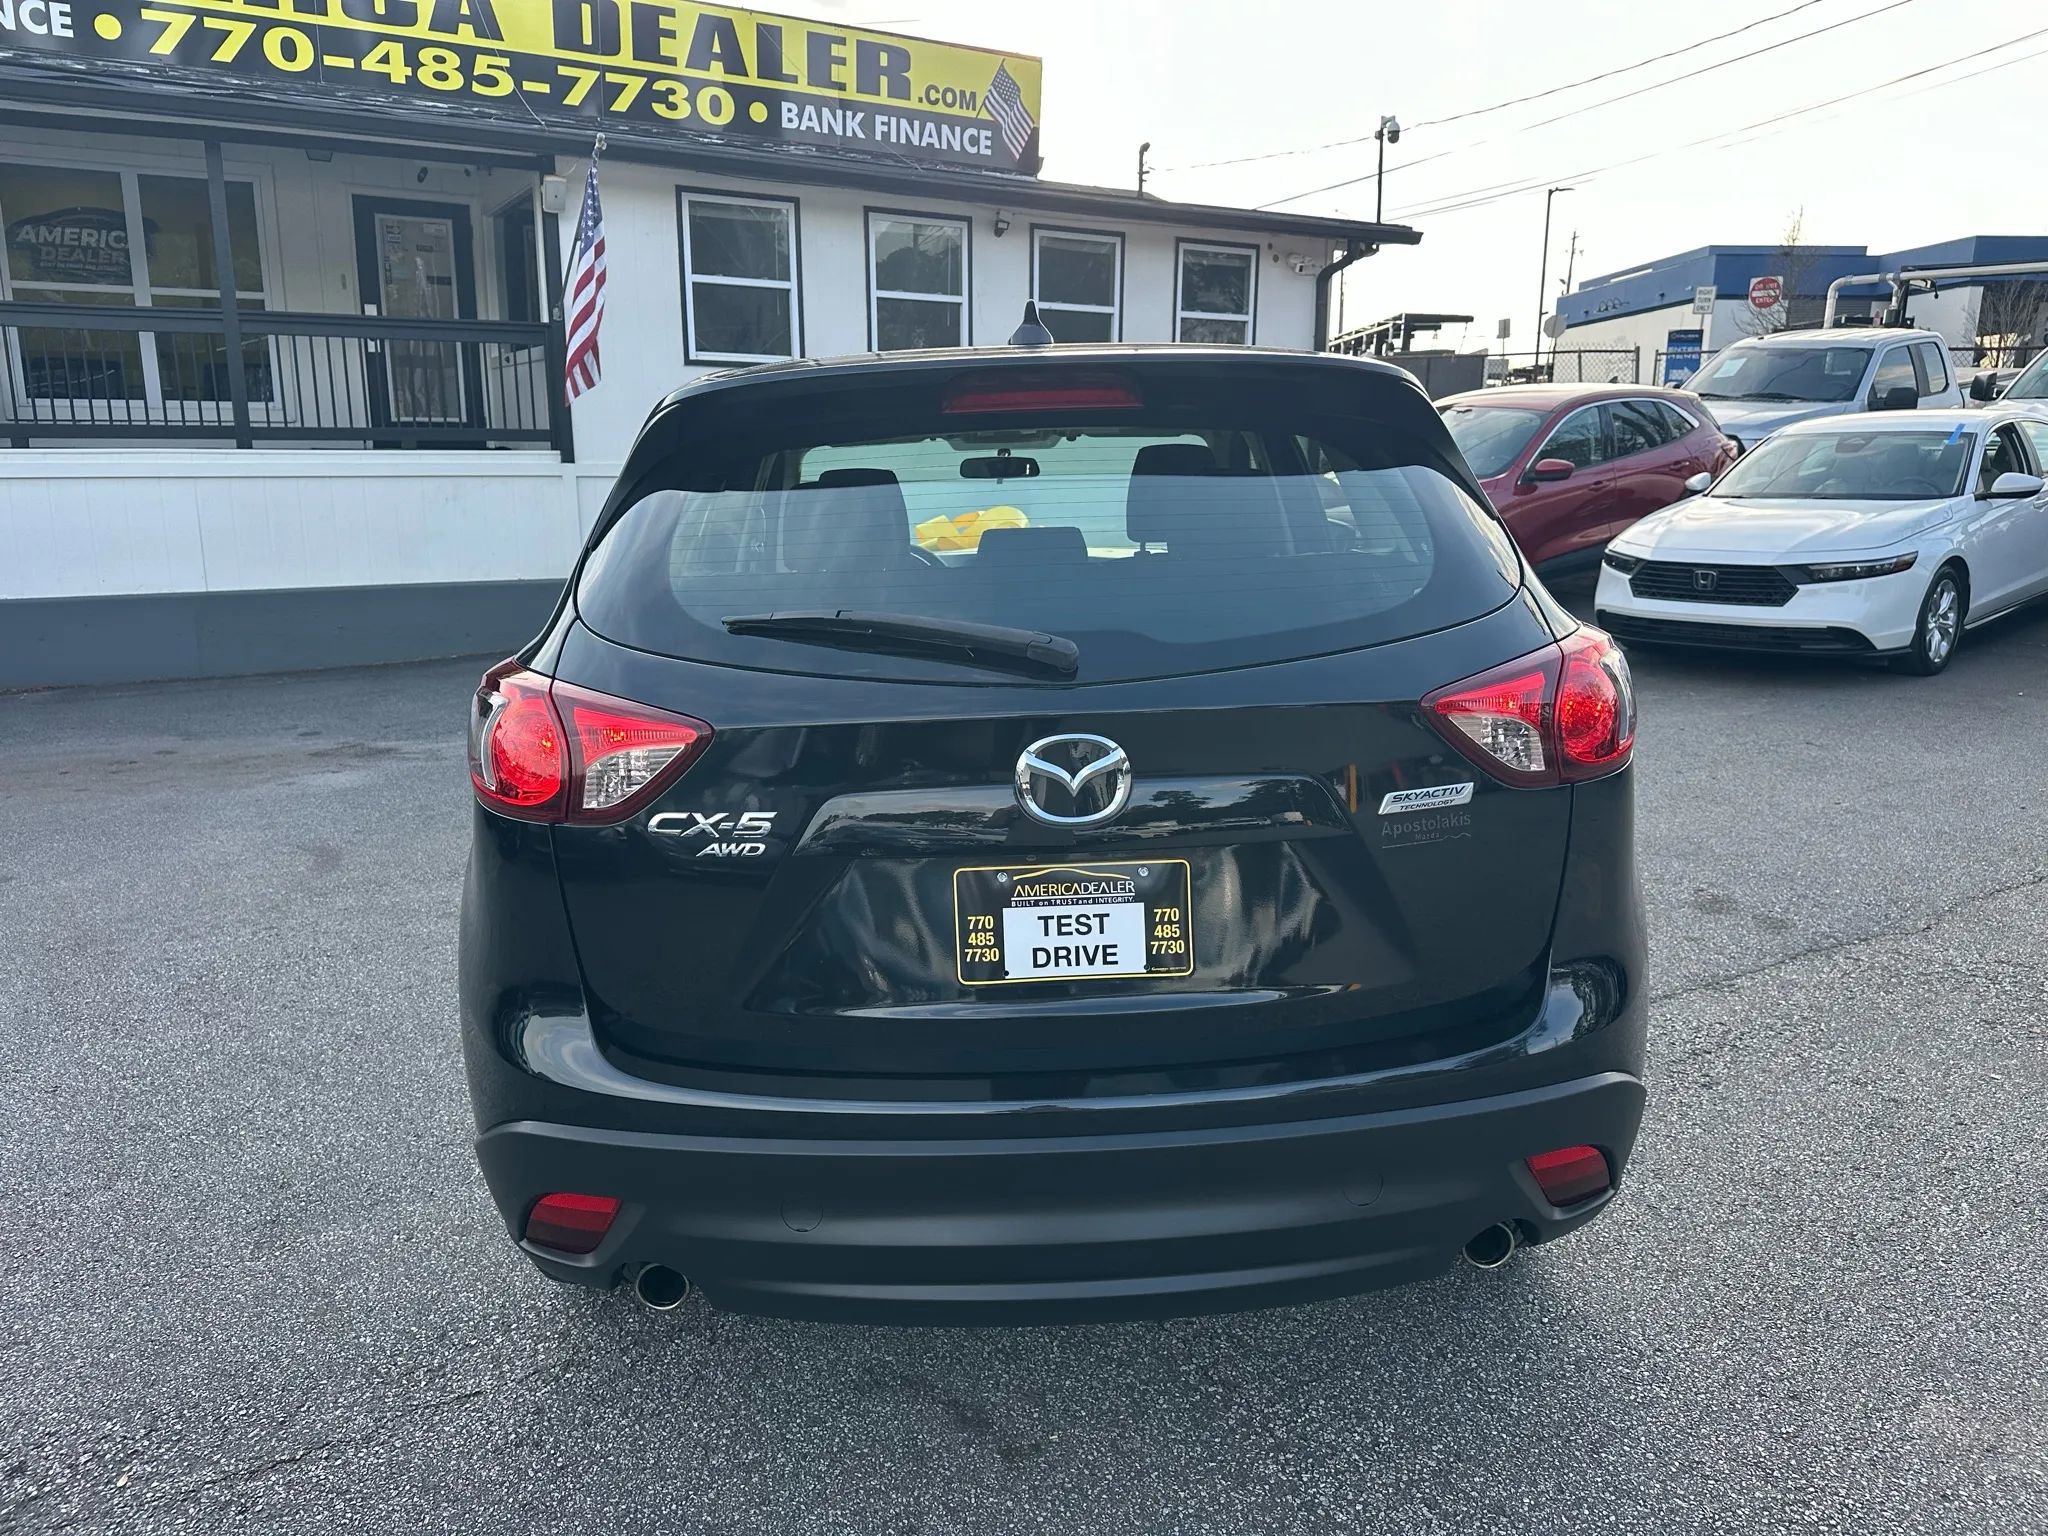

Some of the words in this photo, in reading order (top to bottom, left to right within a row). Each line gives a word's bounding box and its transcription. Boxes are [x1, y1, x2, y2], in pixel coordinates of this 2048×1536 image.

[552, 0, 913, 101] DEALER
[139, 8, 736, 127] 770-485-7730
[780, 100, 866, 140] BANK
[874, 115, 994, 156] FINANCE
[16, 224, 129, 249] AMERIC
[1391, 785, 1466, 803] SKYACTIV
[1400, 798, 1456, 811] TECHNOLOGY
[647, 810, 779, 838] CX-5
[1381, 811, 1471, 838] Apostolakis
[695, 841, 766, 858] AWD
[1013, 880, 1136, 897] AMERICADEALER
[1011, 899, 1036, 908] BUILT
[967, 915, 994, 930] 770
[1154, 907, 1180, 922] 770
[1037, 913, 1110, 937] TEST
[1154, 924, 1181, 939] 485
[967, 931, 995, 946] 485
[1150, 939, 1185, 955] 7730
[964, 947, 1000, 963] 7730
[1032, 944, 1119, 969] DRIVE
